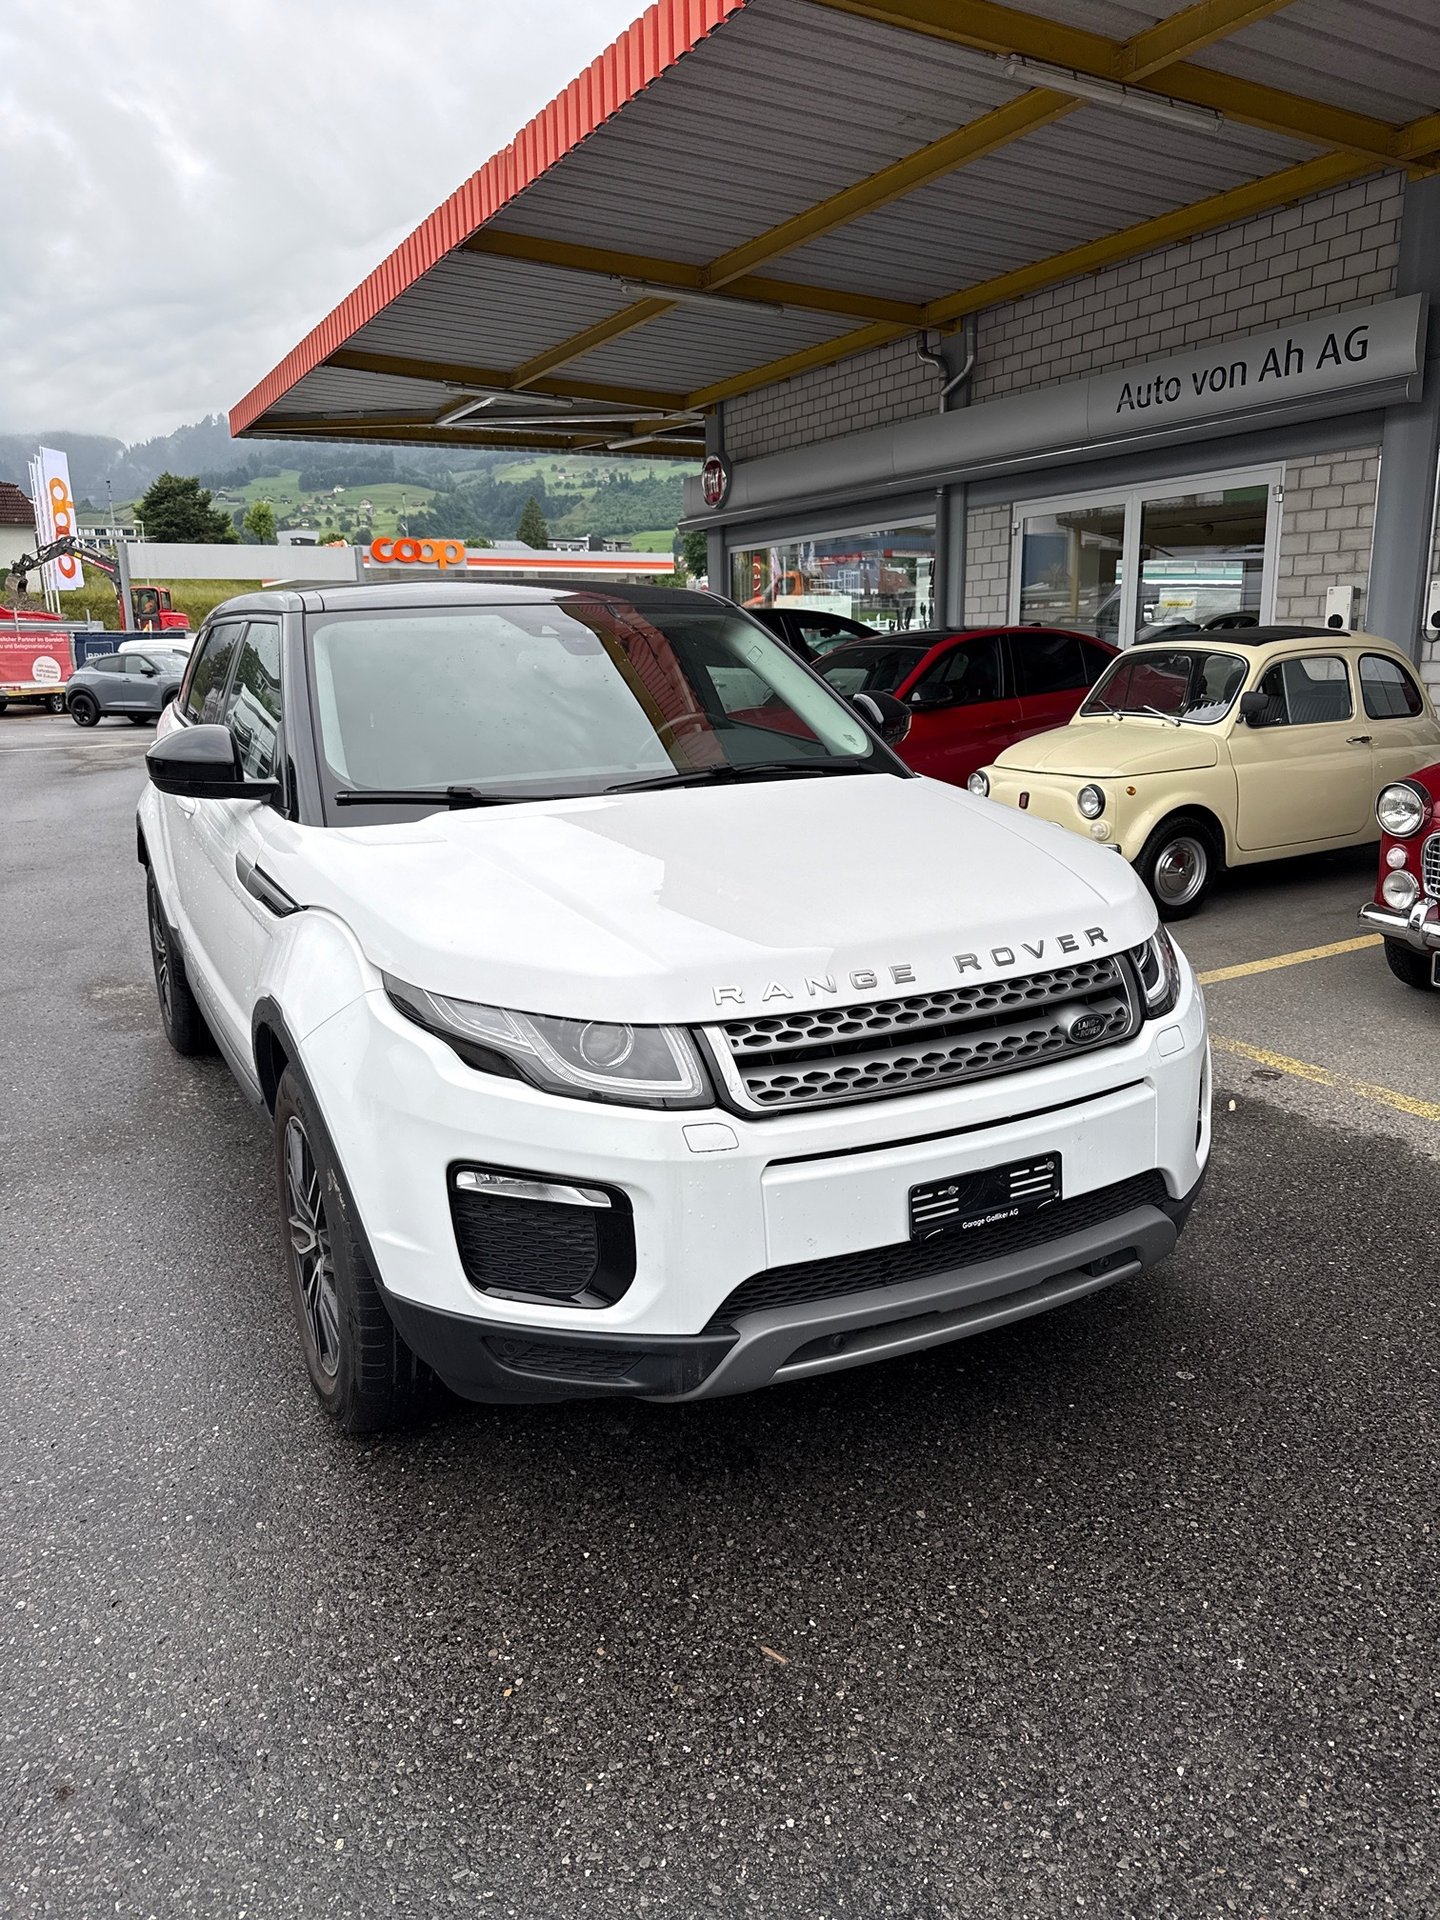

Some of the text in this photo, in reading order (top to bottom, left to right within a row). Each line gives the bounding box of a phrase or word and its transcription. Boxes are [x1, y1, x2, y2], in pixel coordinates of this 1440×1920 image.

[1116, 325, 1370, 413] Auto von Ah AG
[370, 537, 465, 570] coop
[711, 926, 1109, 1006] RANGE ROVER
[1078, 1019, 1096, 1030] LAND
[1080, 1025, 1101, 1037] ROVER
[962, 1208, 1019, 1229] Garage Galliker AG
